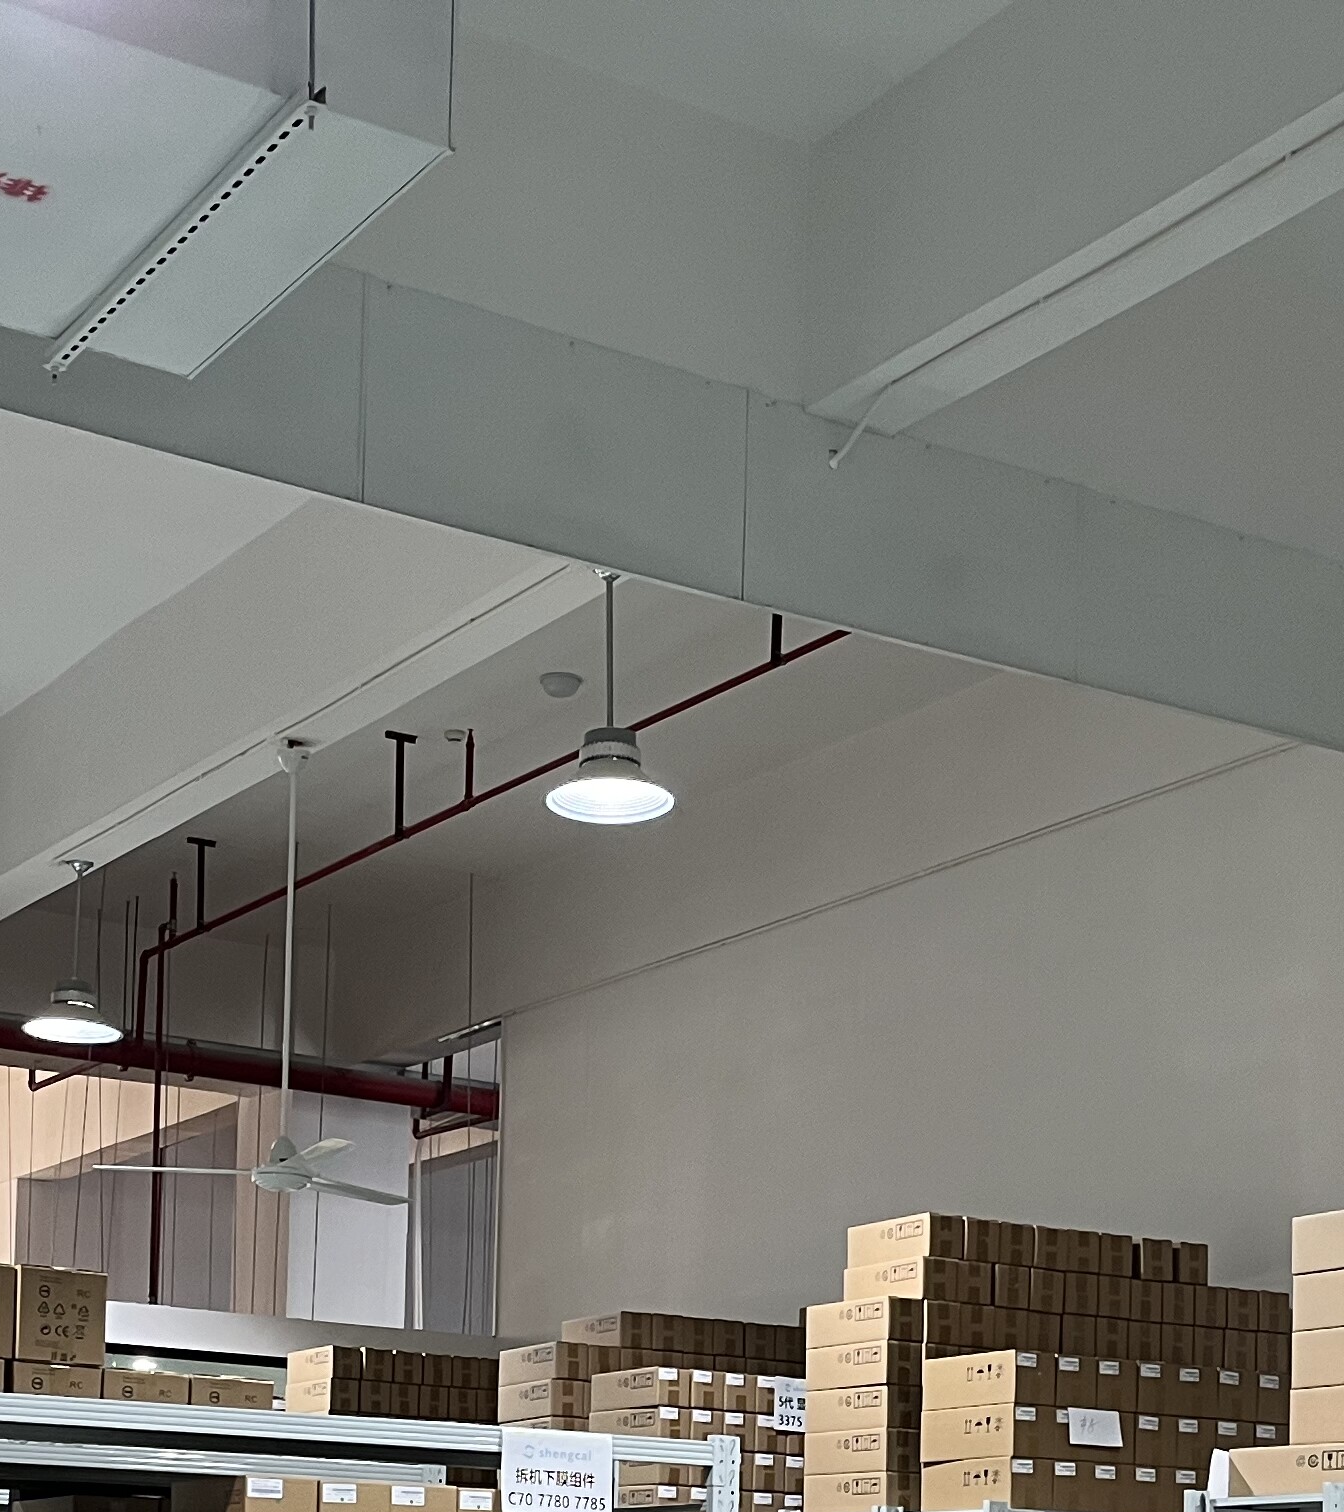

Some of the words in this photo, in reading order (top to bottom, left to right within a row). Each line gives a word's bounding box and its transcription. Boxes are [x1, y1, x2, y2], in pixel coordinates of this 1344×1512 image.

[778, 1414, 803, 1427] 3375
[508, 1491, 533, 1506] C70
[537, 1493, 570, 1509] 7780
[574, 1495, 606, 1511] 7785
